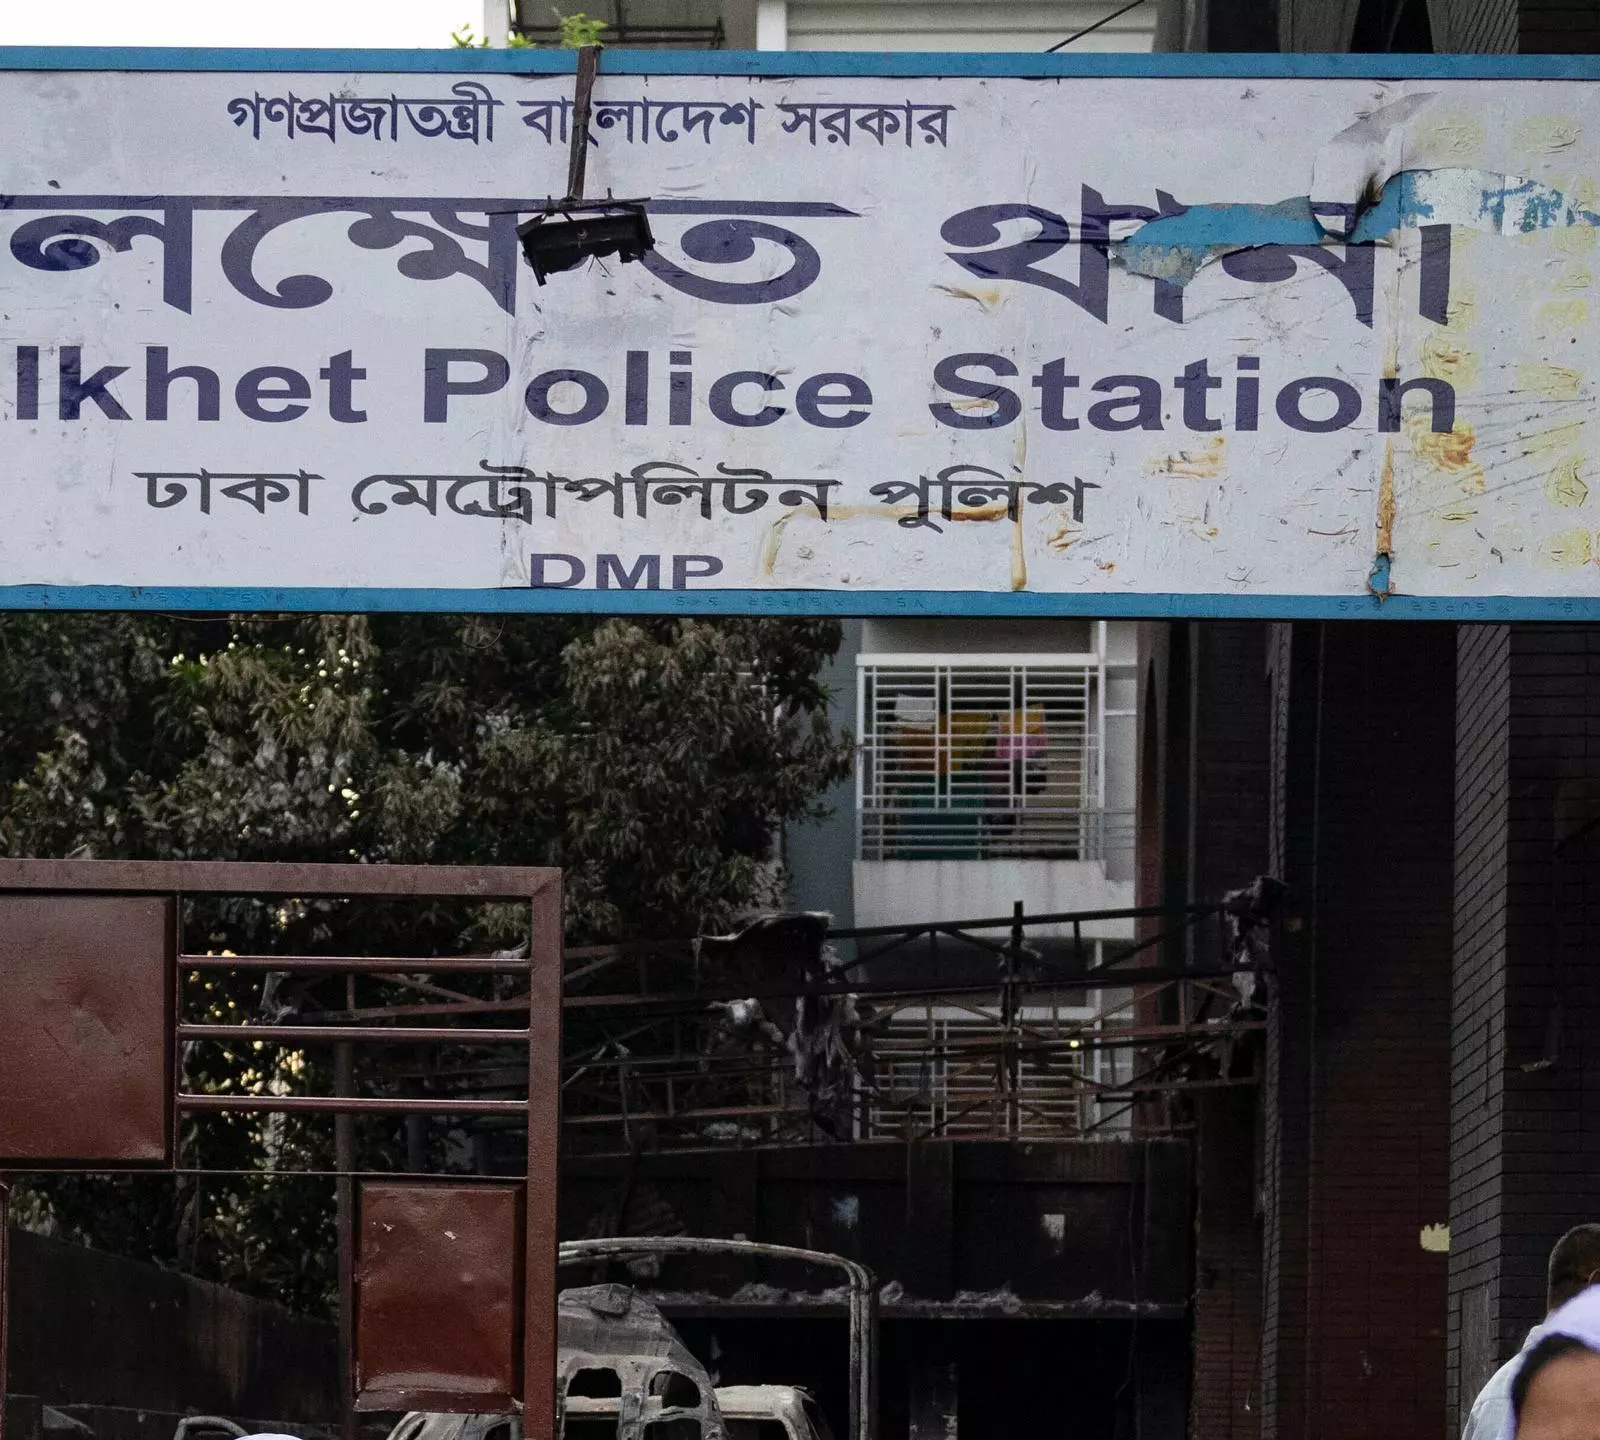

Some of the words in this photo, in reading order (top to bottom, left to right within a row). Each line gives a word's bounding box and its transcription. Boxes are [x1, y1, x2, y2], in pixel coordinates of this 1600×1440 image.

[227, 81, 504, 145] গণপ্রজাতন্ত্রী
[776, 97, 956, 148] সরকার
[424, 348, 872, 429] Police
[929, 352, 1455, 434] Station
[132, 468, 325, 516] ঢাকা
[352, 459, 841, 526] মেট্রোপলিটন
[869, 465, 1100, 533] পুলিশ
[529, 553, 725, 591] DMP
